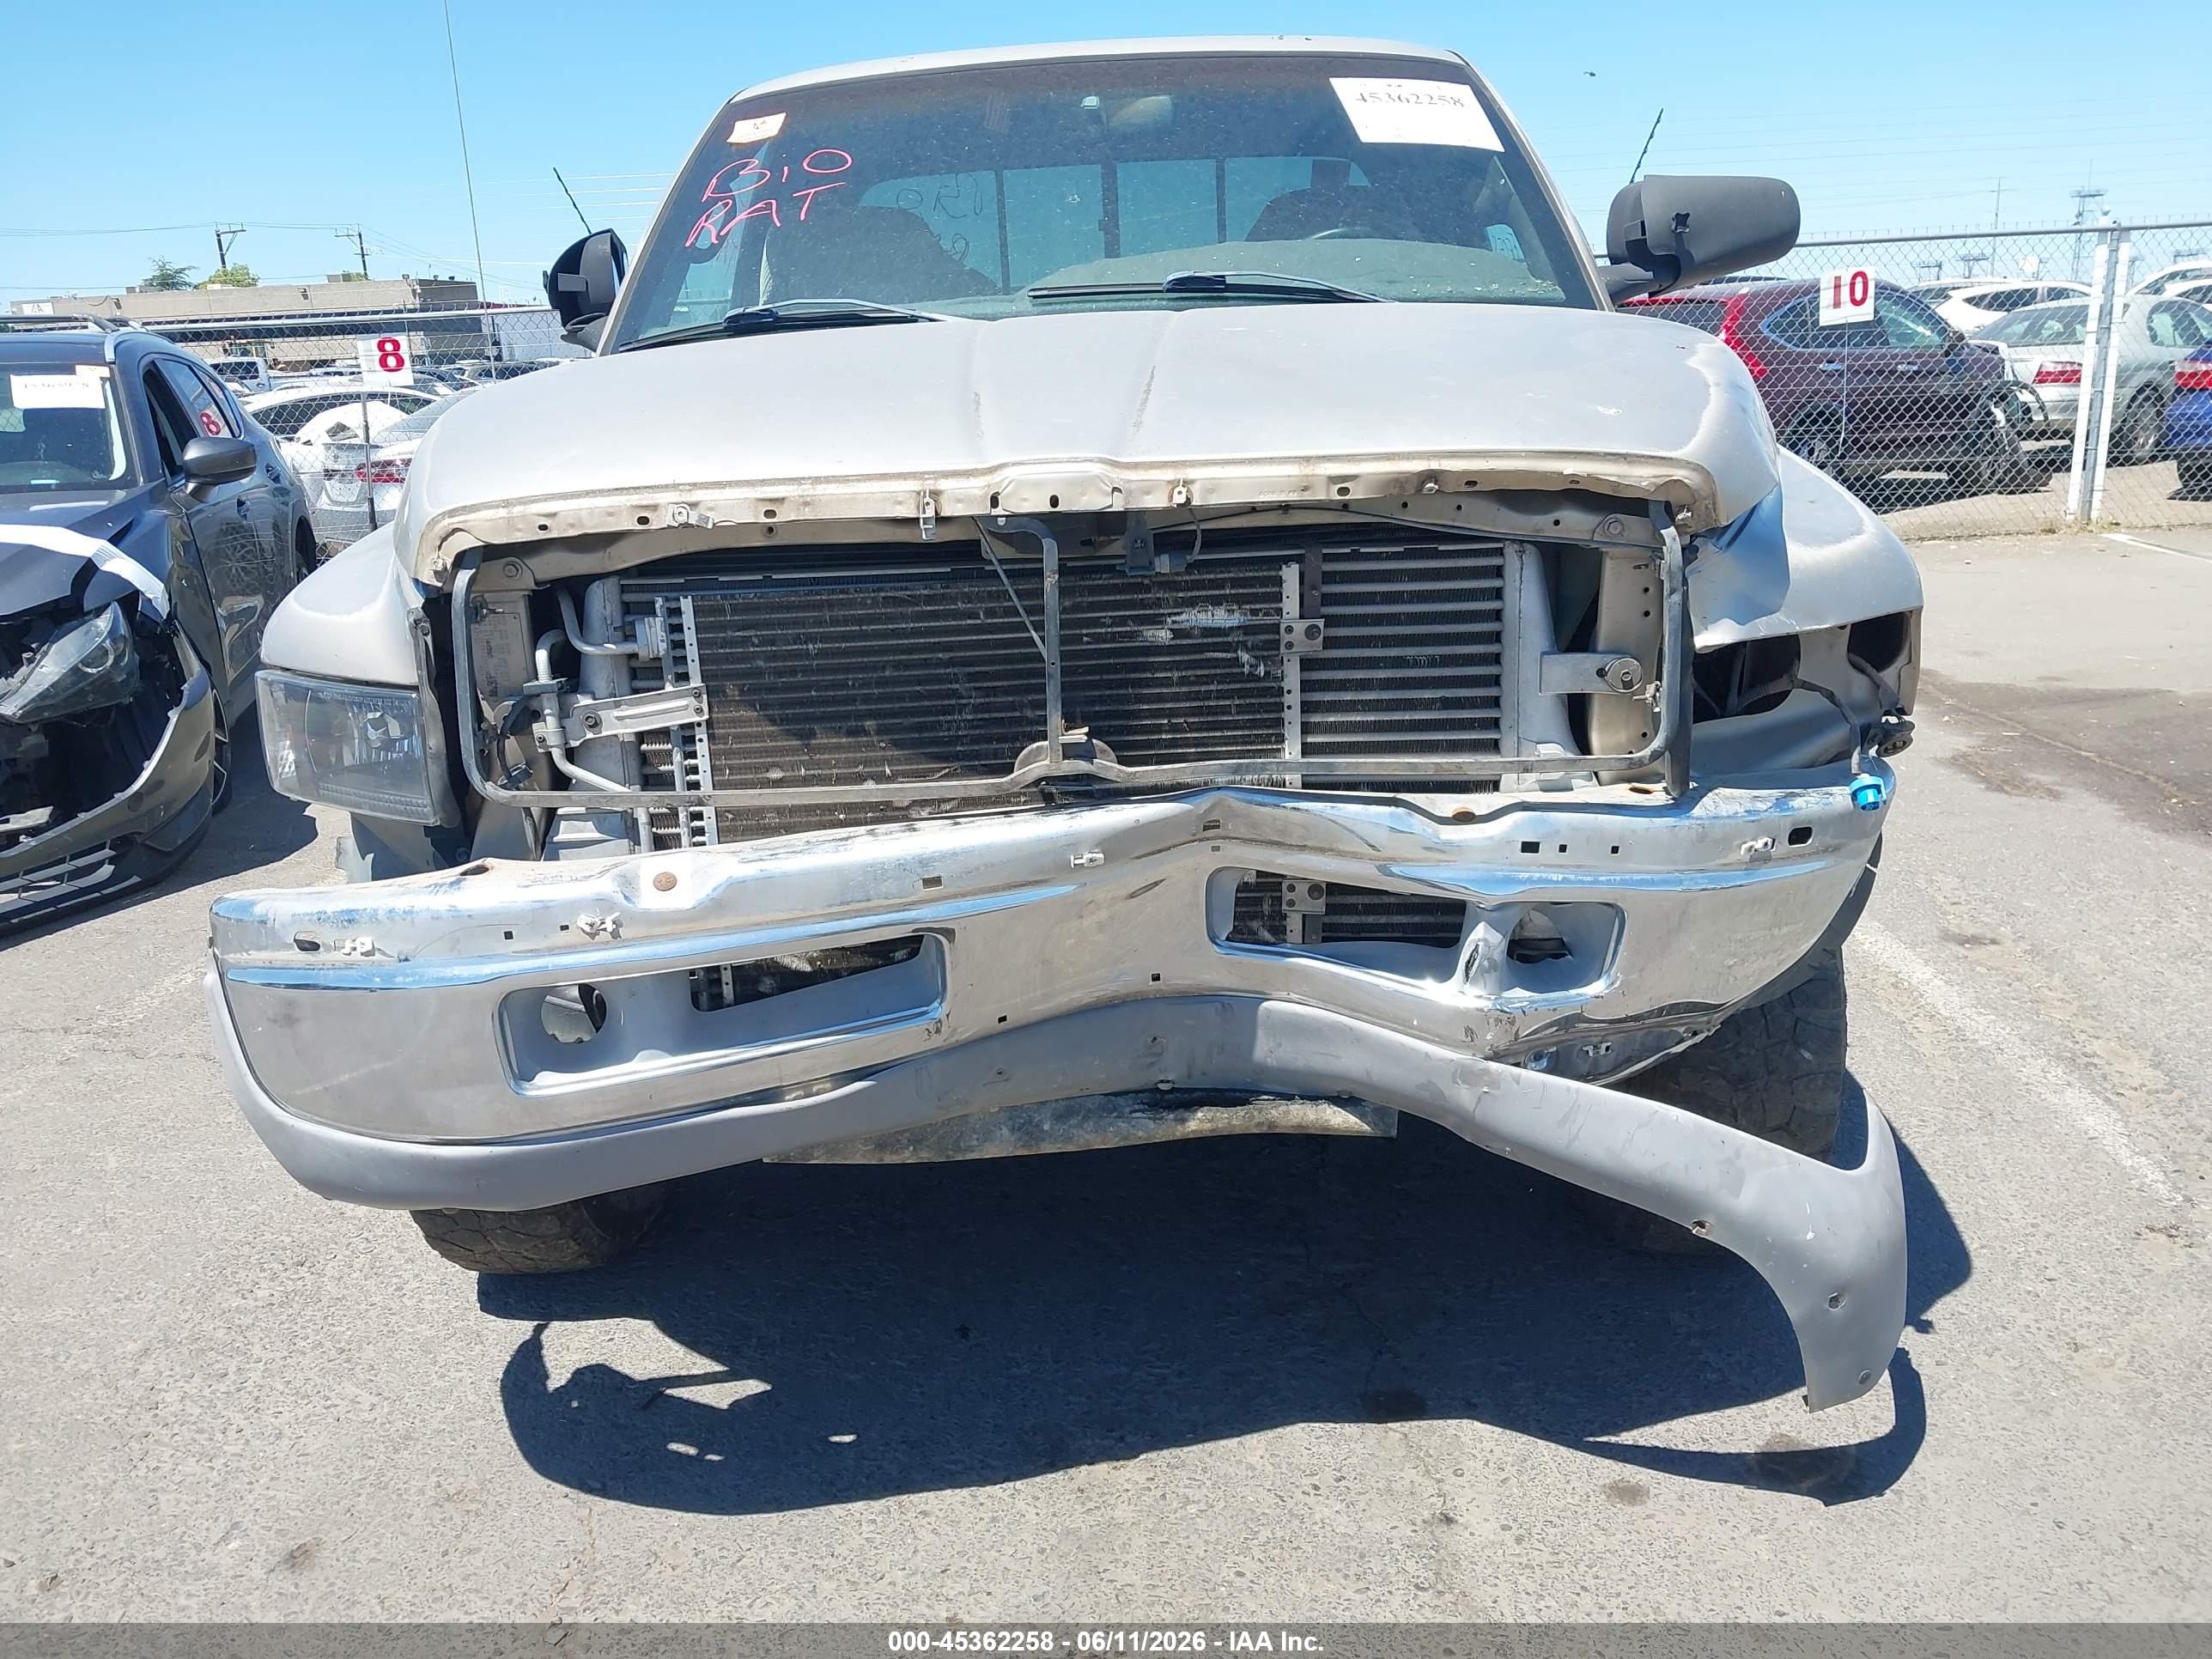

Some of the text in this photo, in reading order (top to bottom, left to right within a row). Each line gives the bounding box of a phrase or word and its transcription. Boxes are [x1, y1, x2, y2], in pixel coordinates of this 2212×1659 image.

[1355, 91, 1465, 108] 45362258
[684, 180, 847, 248] RAT
[1832, 270, 1869, 310] 10
[376, 337, 405, 373] 8
[199, 411, 222, 436] 8
